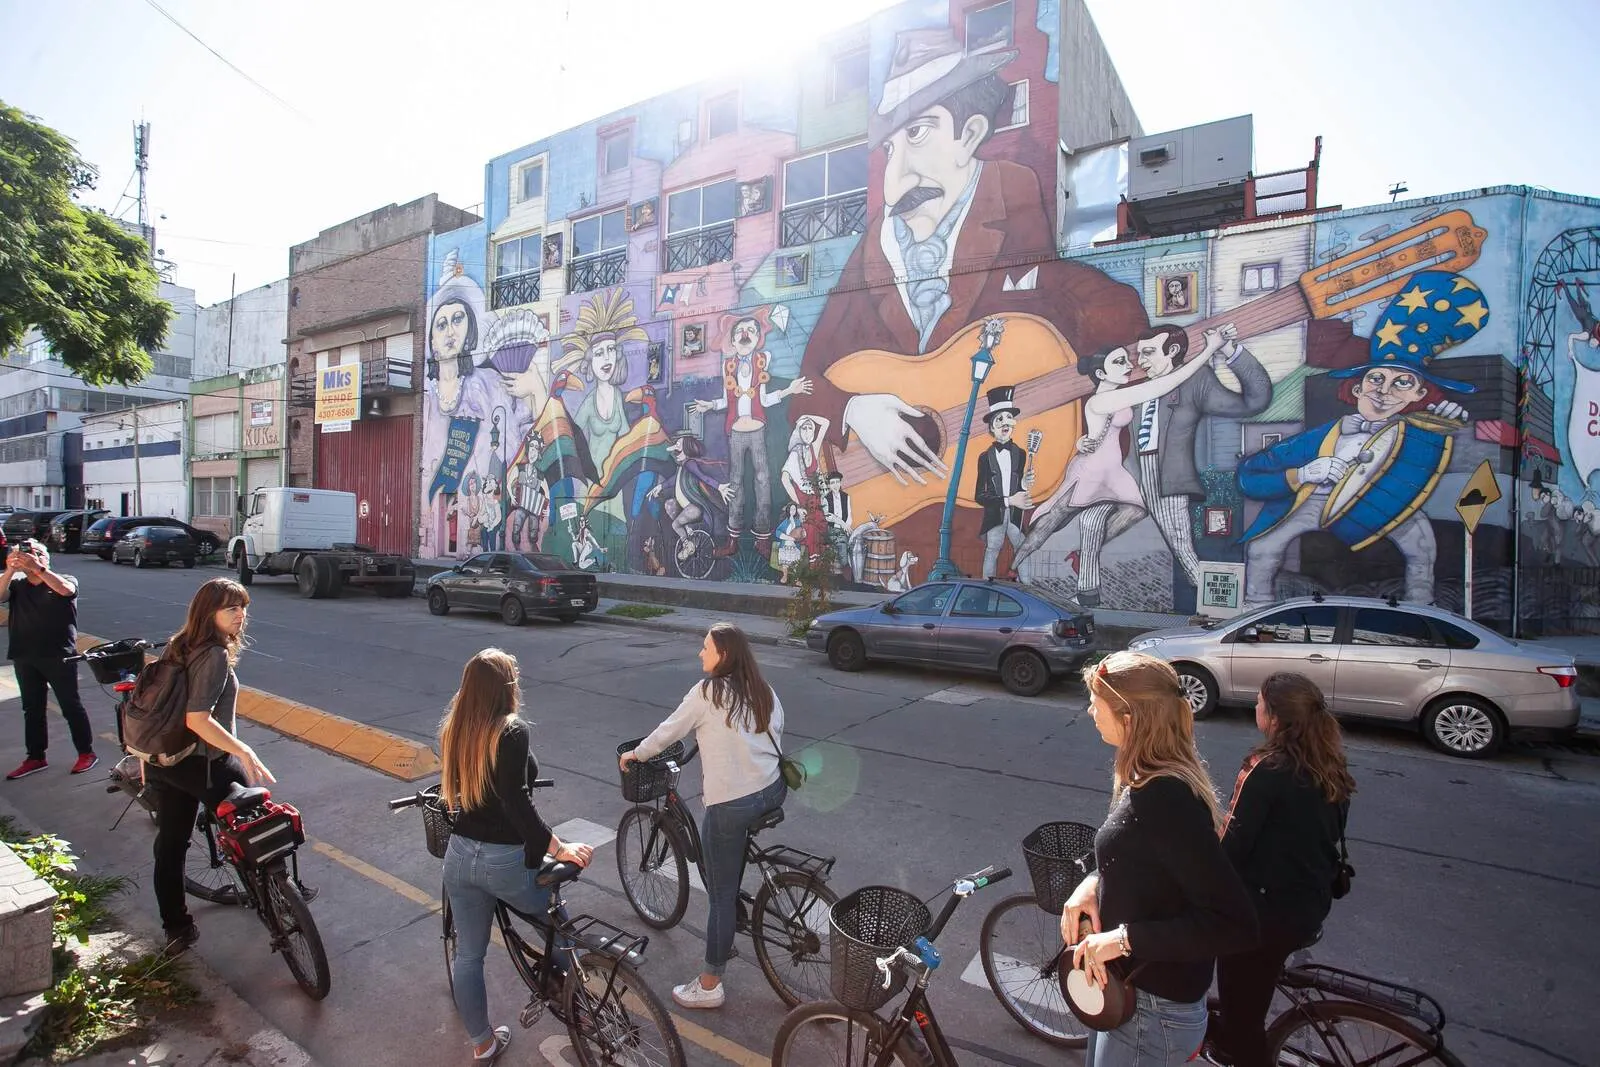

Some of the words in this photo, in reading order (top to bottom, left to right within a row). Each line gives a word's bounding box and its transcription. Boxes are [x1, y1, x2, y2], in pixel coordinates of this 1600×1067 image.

[323, 370, 352, 390] Mks
[321, 393, 353, 404] VENDE
[1589, 400, 1600, 417] D
[1587, 419, 1600, 437] C
